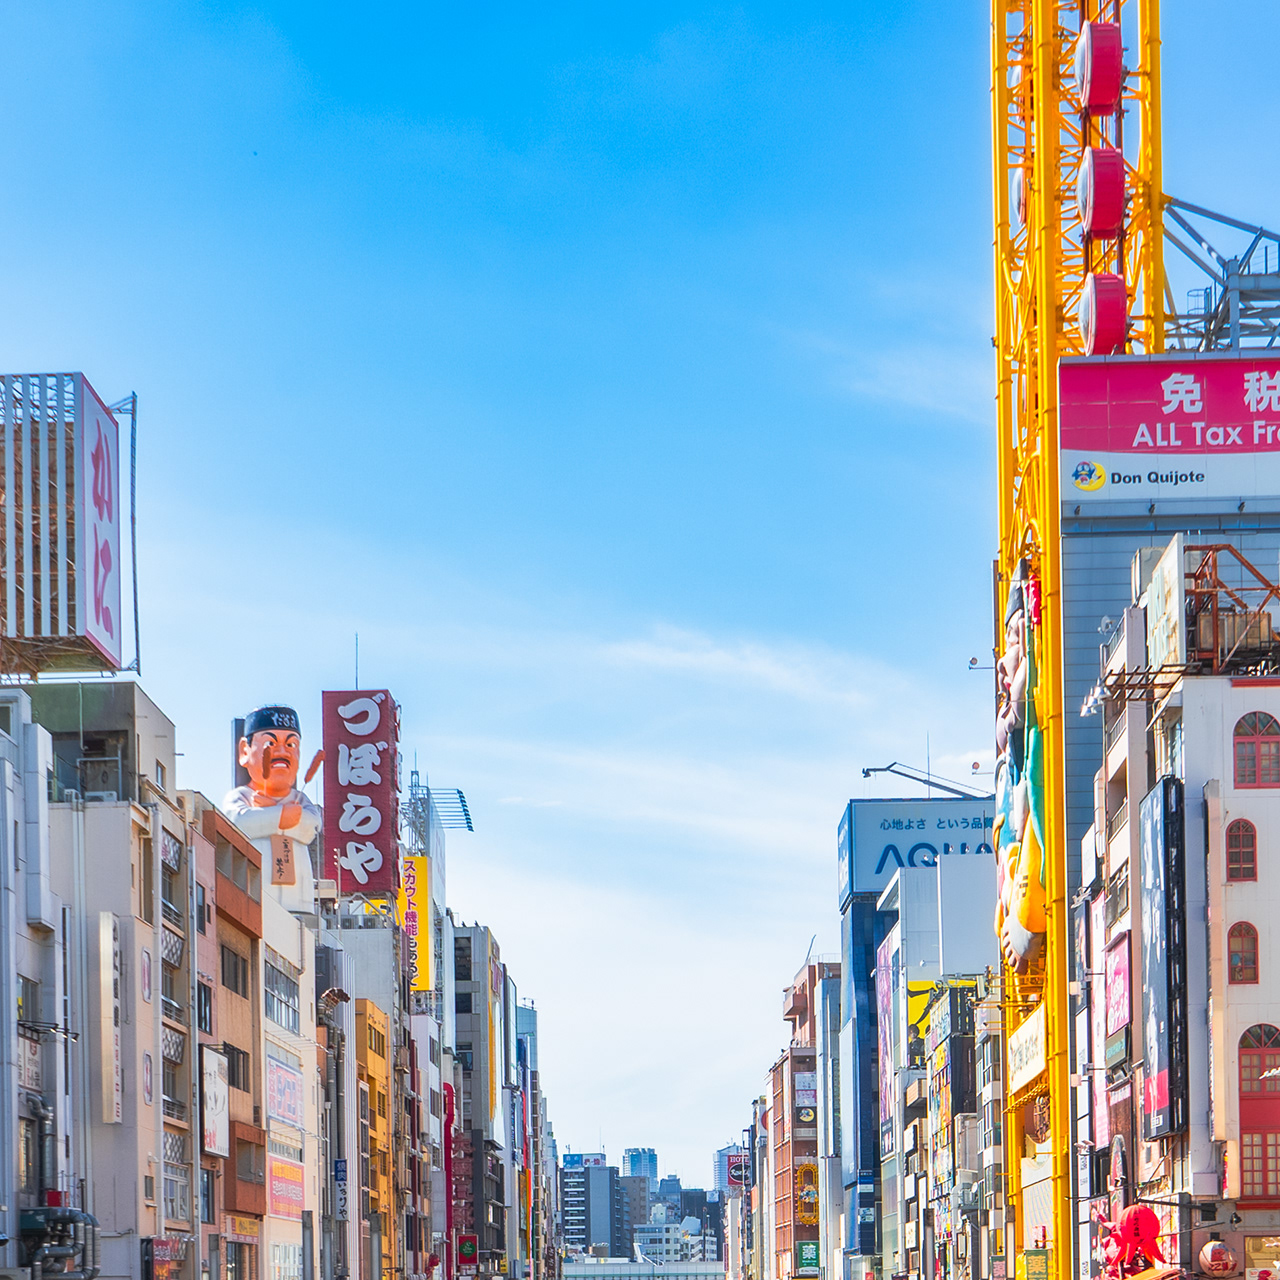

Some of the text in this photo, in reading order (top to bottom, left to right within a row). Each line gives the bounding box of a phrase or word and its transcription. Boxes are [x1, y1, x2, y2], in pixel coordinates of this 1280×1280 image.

[1132, 423, 1181, 447] ALL
[1192, 421, 1243, 446] Tax
[1110, 470, 1205, 486] Don Quijote
[338, 693, 386, 885] づぼらや
[880, 818, 927, 830] 心地よさ
